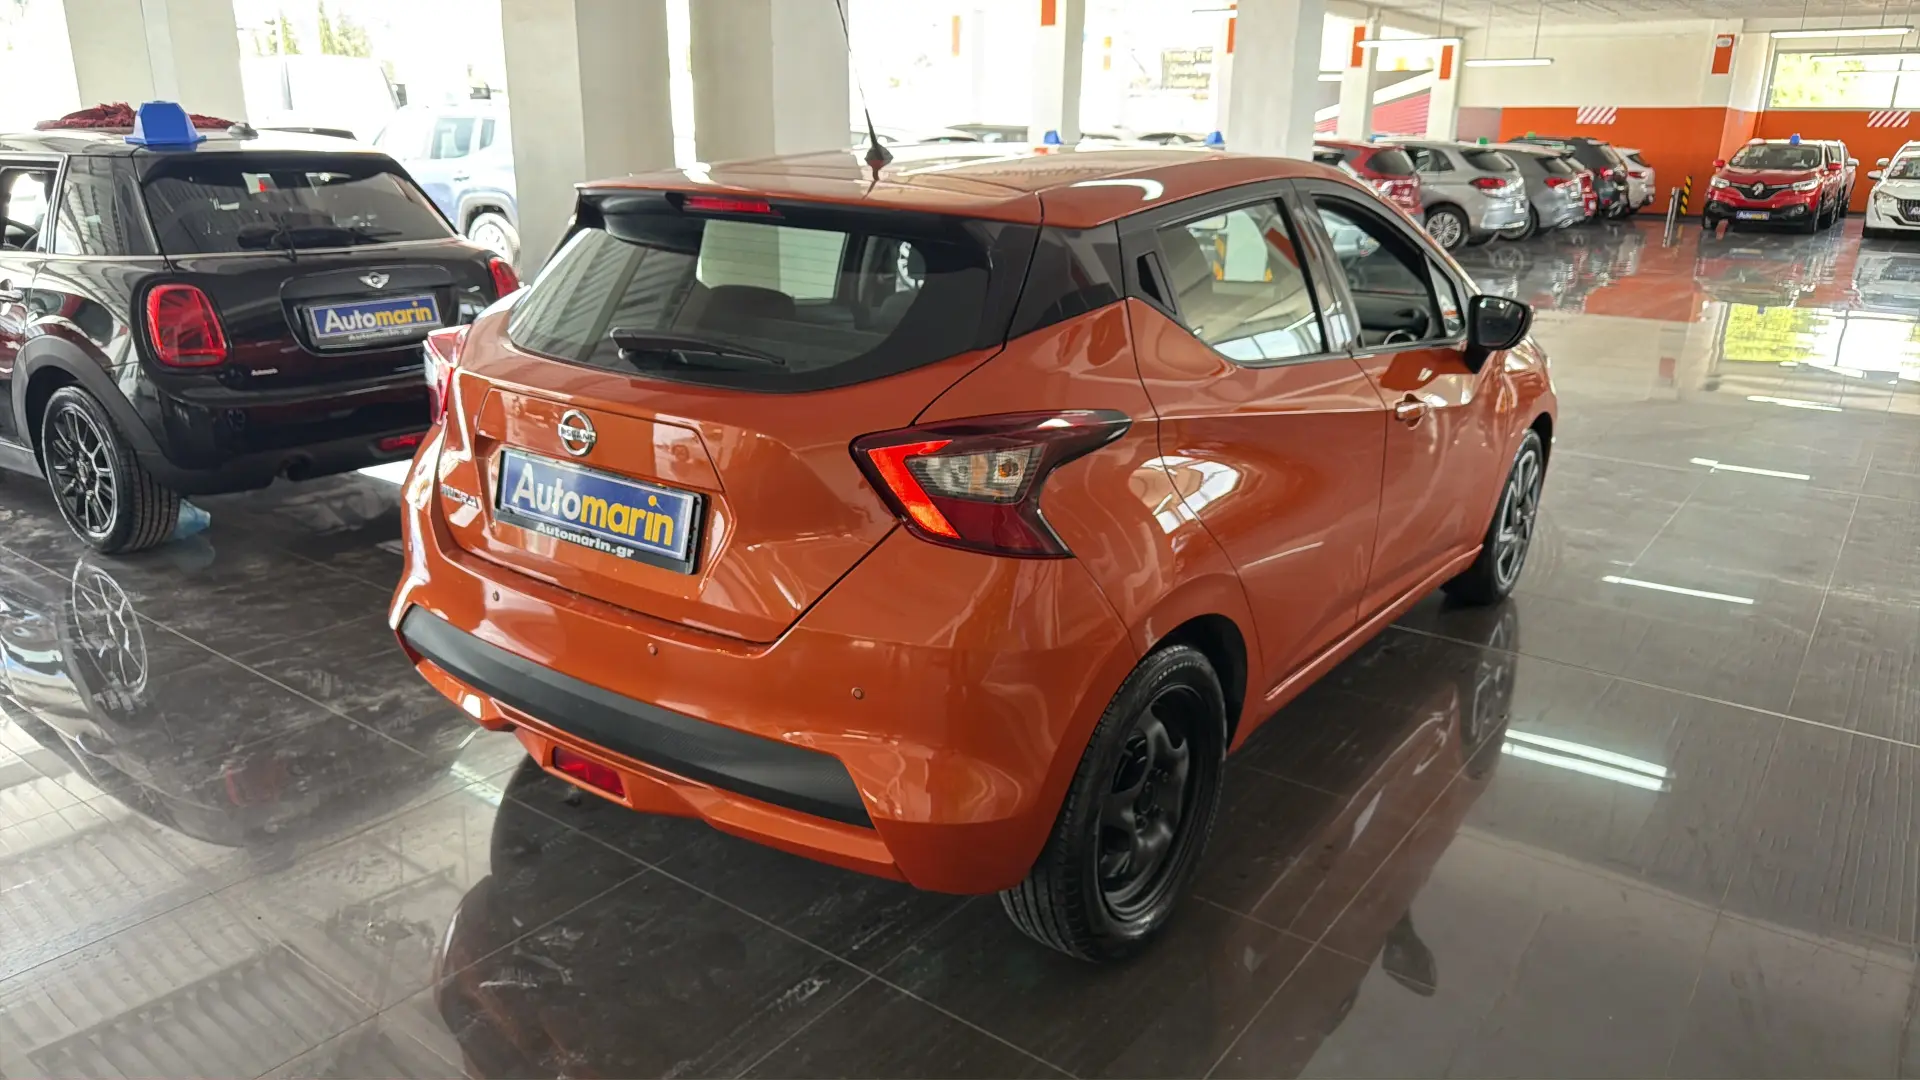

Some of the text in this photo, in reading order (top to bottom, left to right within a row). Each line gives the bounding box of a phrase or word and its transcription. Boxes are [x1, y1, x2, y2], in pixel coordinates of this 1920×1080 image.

[325, 300, 433, 333] Automarin
[512, 462, 674, 546] Automarin
[536, 522, 635, 558] Automarin.gr
